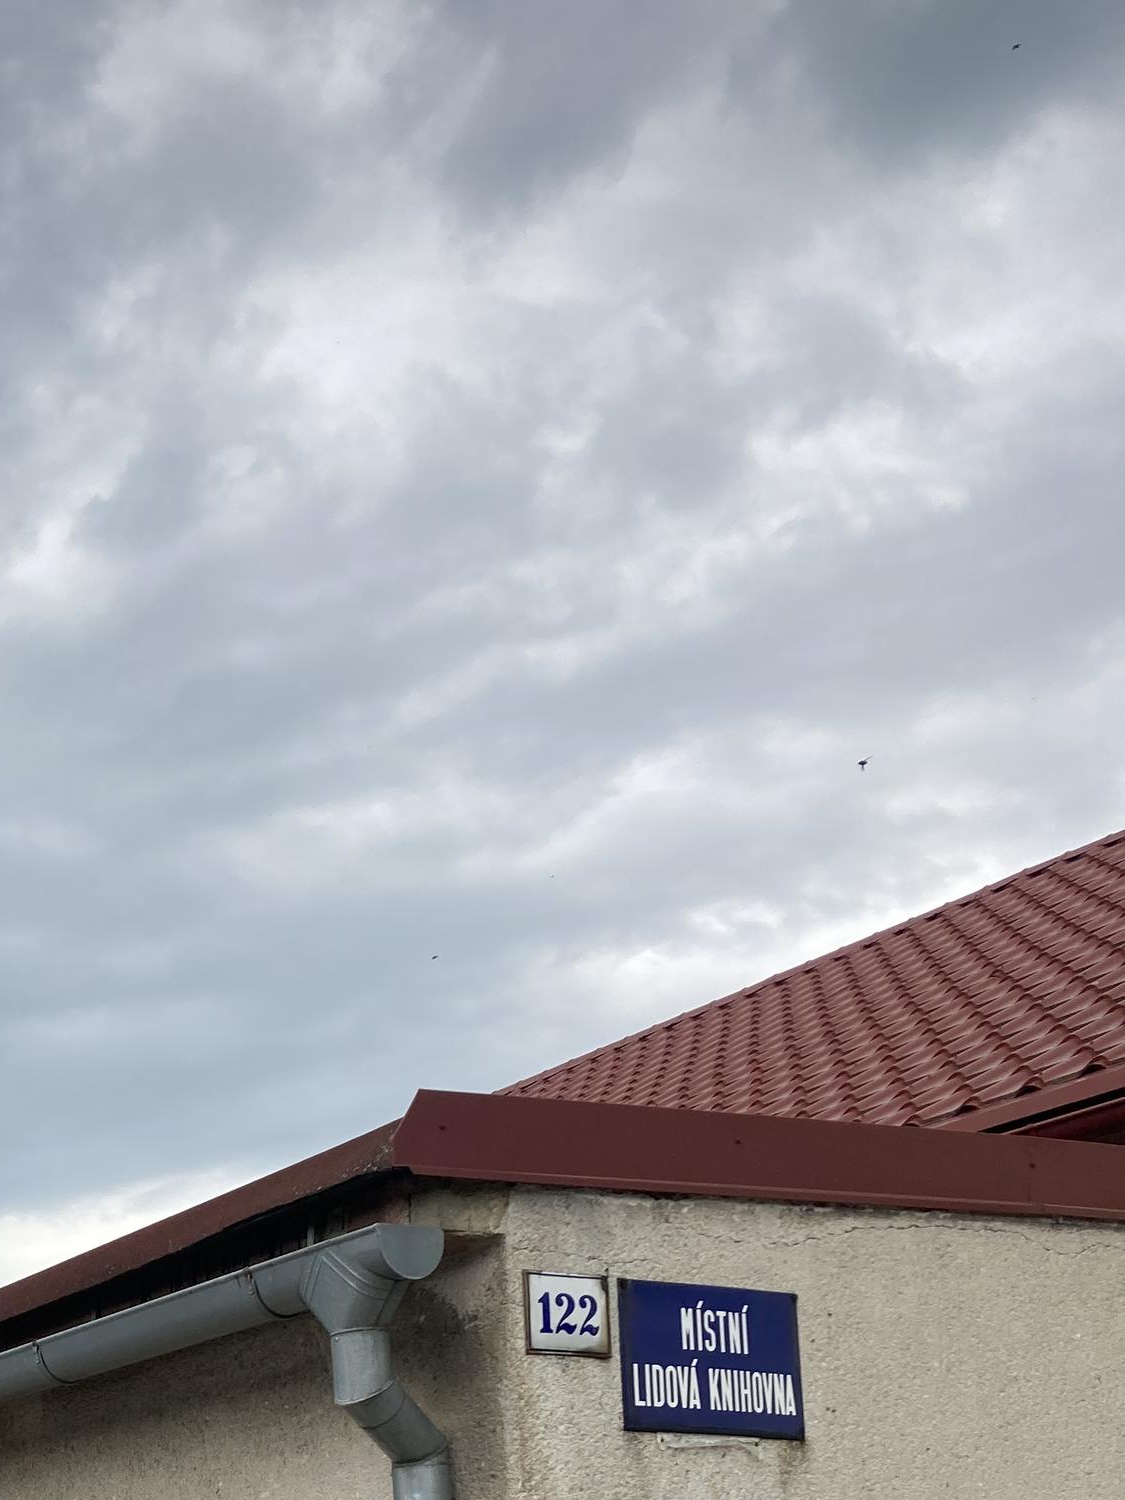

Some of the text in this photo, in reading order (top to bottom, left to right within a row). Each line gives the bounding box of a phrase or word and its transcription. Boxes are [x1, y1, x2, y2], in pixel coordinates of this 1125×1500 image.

[537, 1291, 600, 1337] 122
[680, 1300, 749, 1355] MÍSTNÍ
[632, 1358, 797, 1417] LIDOVÁ KNIHOVNA
